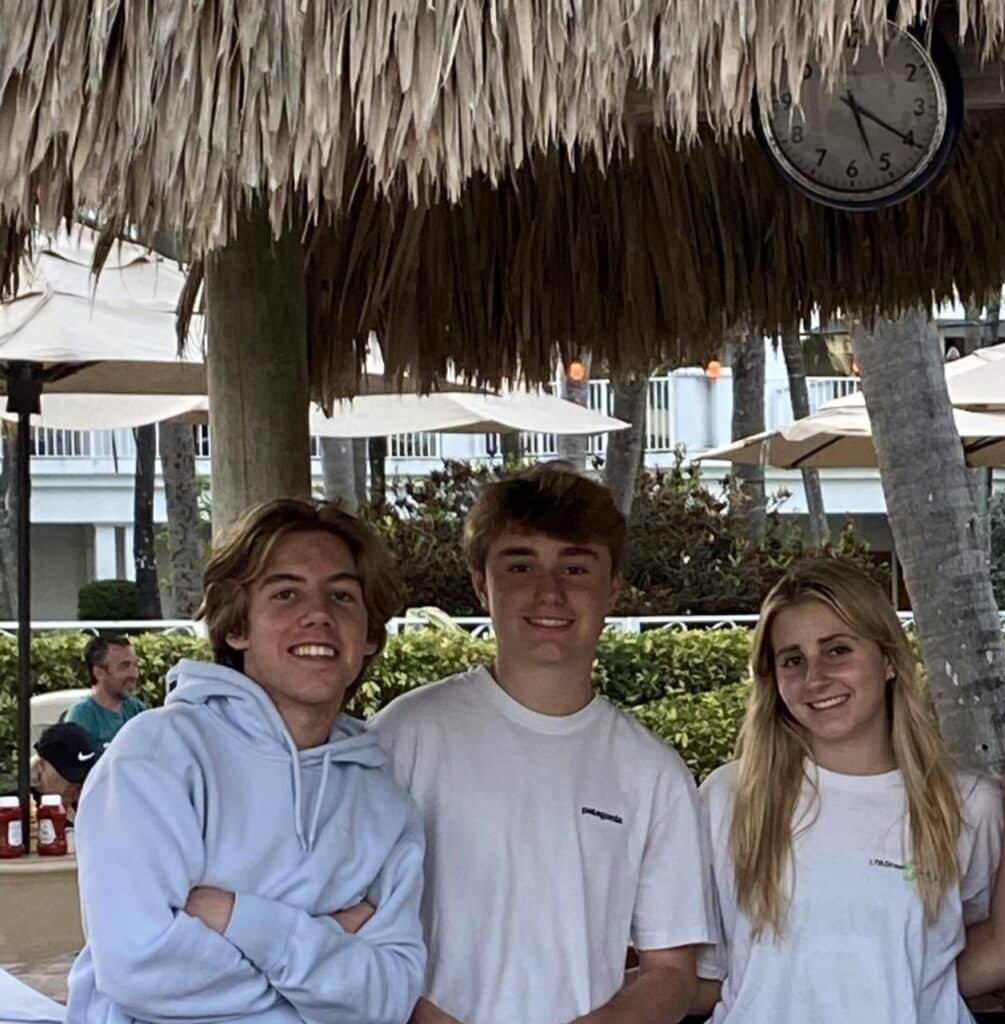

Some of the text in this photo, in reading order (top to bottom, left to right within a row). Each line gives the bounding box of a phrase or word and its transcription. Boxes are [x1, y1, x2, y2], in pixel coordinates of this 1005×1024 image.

[905, 63, 918, 82] 2
[913, 98, 926, 117] 3
[792, 127, 803, 144] 8
[815, 149, 828, 168] 7
[879, 153, 891, 172] 5
[846, 160, 859, 179] 6
